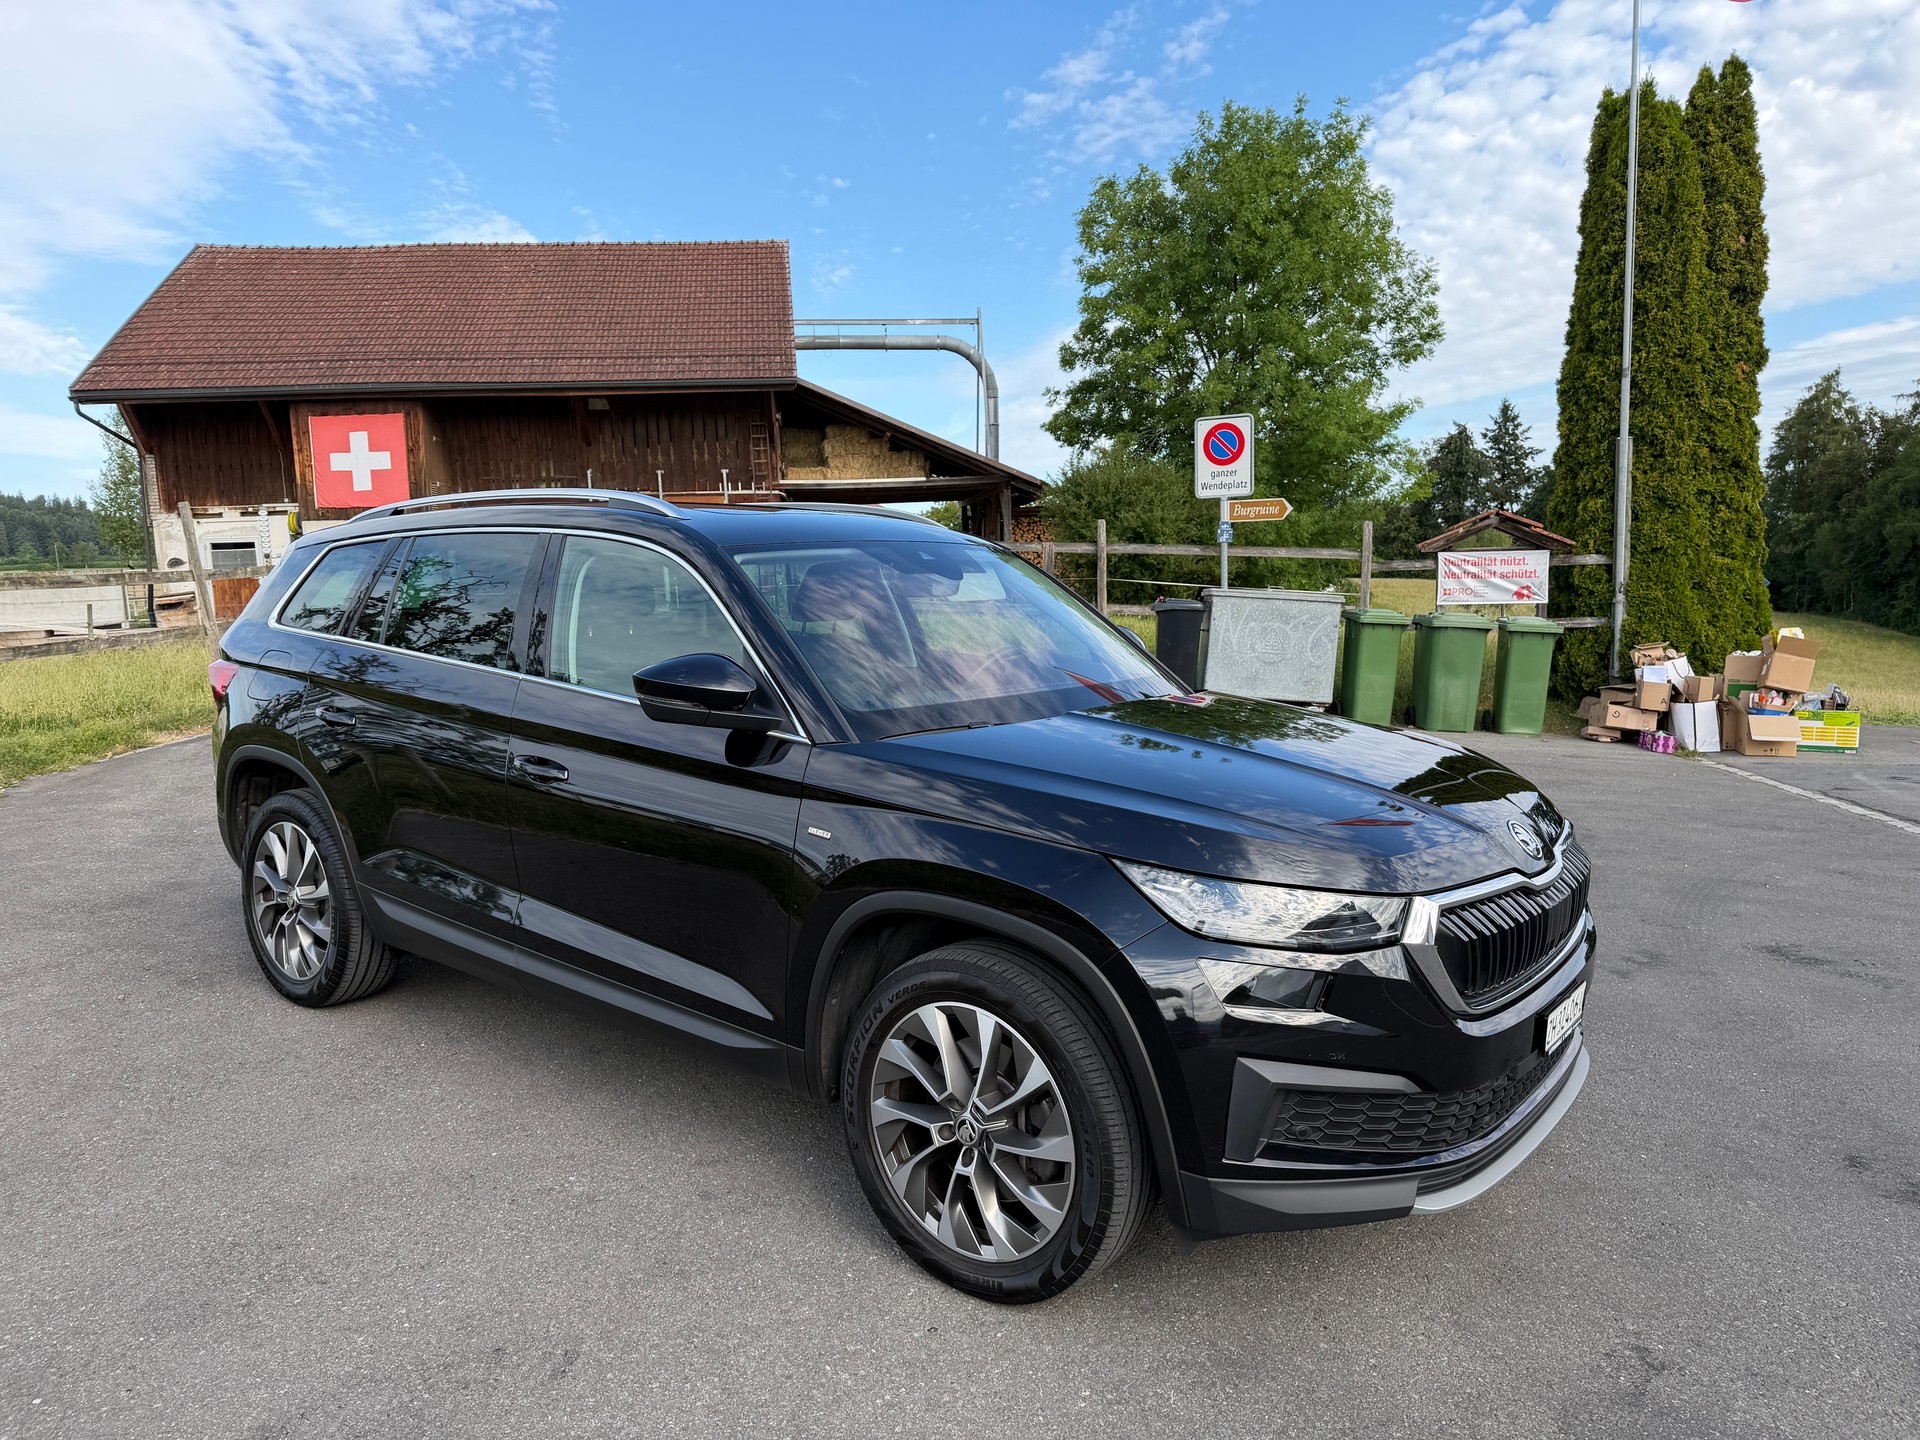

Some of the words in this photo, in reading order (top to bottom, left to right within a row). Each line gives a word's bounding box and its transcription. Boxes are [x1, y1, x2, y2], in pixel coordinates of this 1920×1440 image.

[1210, 469, 1238, 479] ganzer
[1201, 480, 1248, 491] Wendeplatz
[1233, 504, 1280, 517] Burgruine
[1444, 557, 1497, 567] Neutralität
[1500, 556, 1528, 566] nützt.
[1444, 570, 1497, 580] Neutralität
[1500, 569, 1539, 579] schützt.
[1452, 588, 1473, 596] PRO
[844, 1001, 884, 1127] SCORPION
[887, 981, 927, 1004] VERDE
